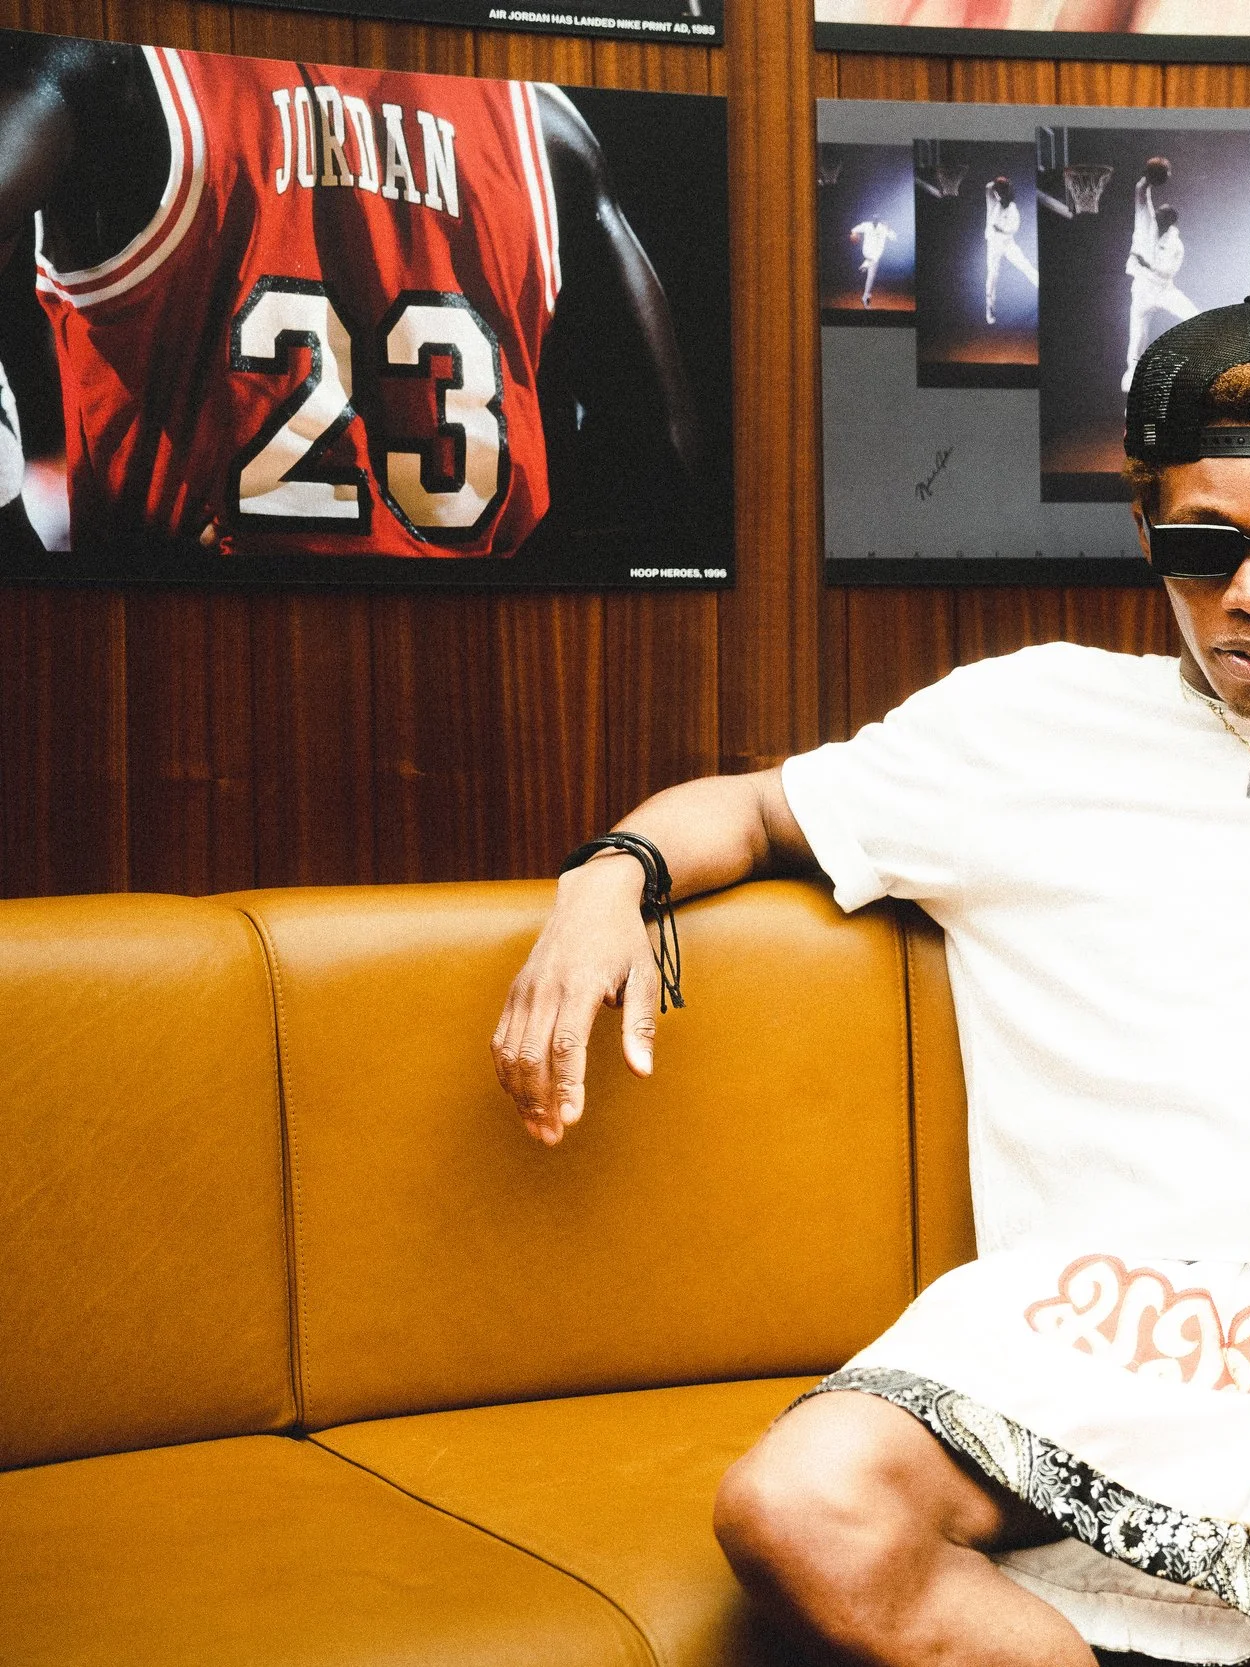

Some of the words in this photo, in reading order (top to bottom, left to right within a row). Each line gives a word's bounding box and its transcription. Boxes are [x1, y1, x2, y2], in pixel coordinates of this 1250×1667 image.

[489, 9, 506, 20] AIR
[508, 11, 550, 24] JORDAN
[551, 14, 573, 26] HAS
[574, 16, 615, 29] LANDED
[617, 19, 641, 31] NIKE
[642, 20, 672, 33] PRINT
[673, 23, 690, 35] AD,
[691, 24, 716, 36] 1985
[271, 84, 460, 218] JORDAN
[236, 285, 503, 531] 23
[630, 567, 659, 579] HOOP
[660, 567, 702, 579] HEROES,
[703, 567, 728, 579] 1996
